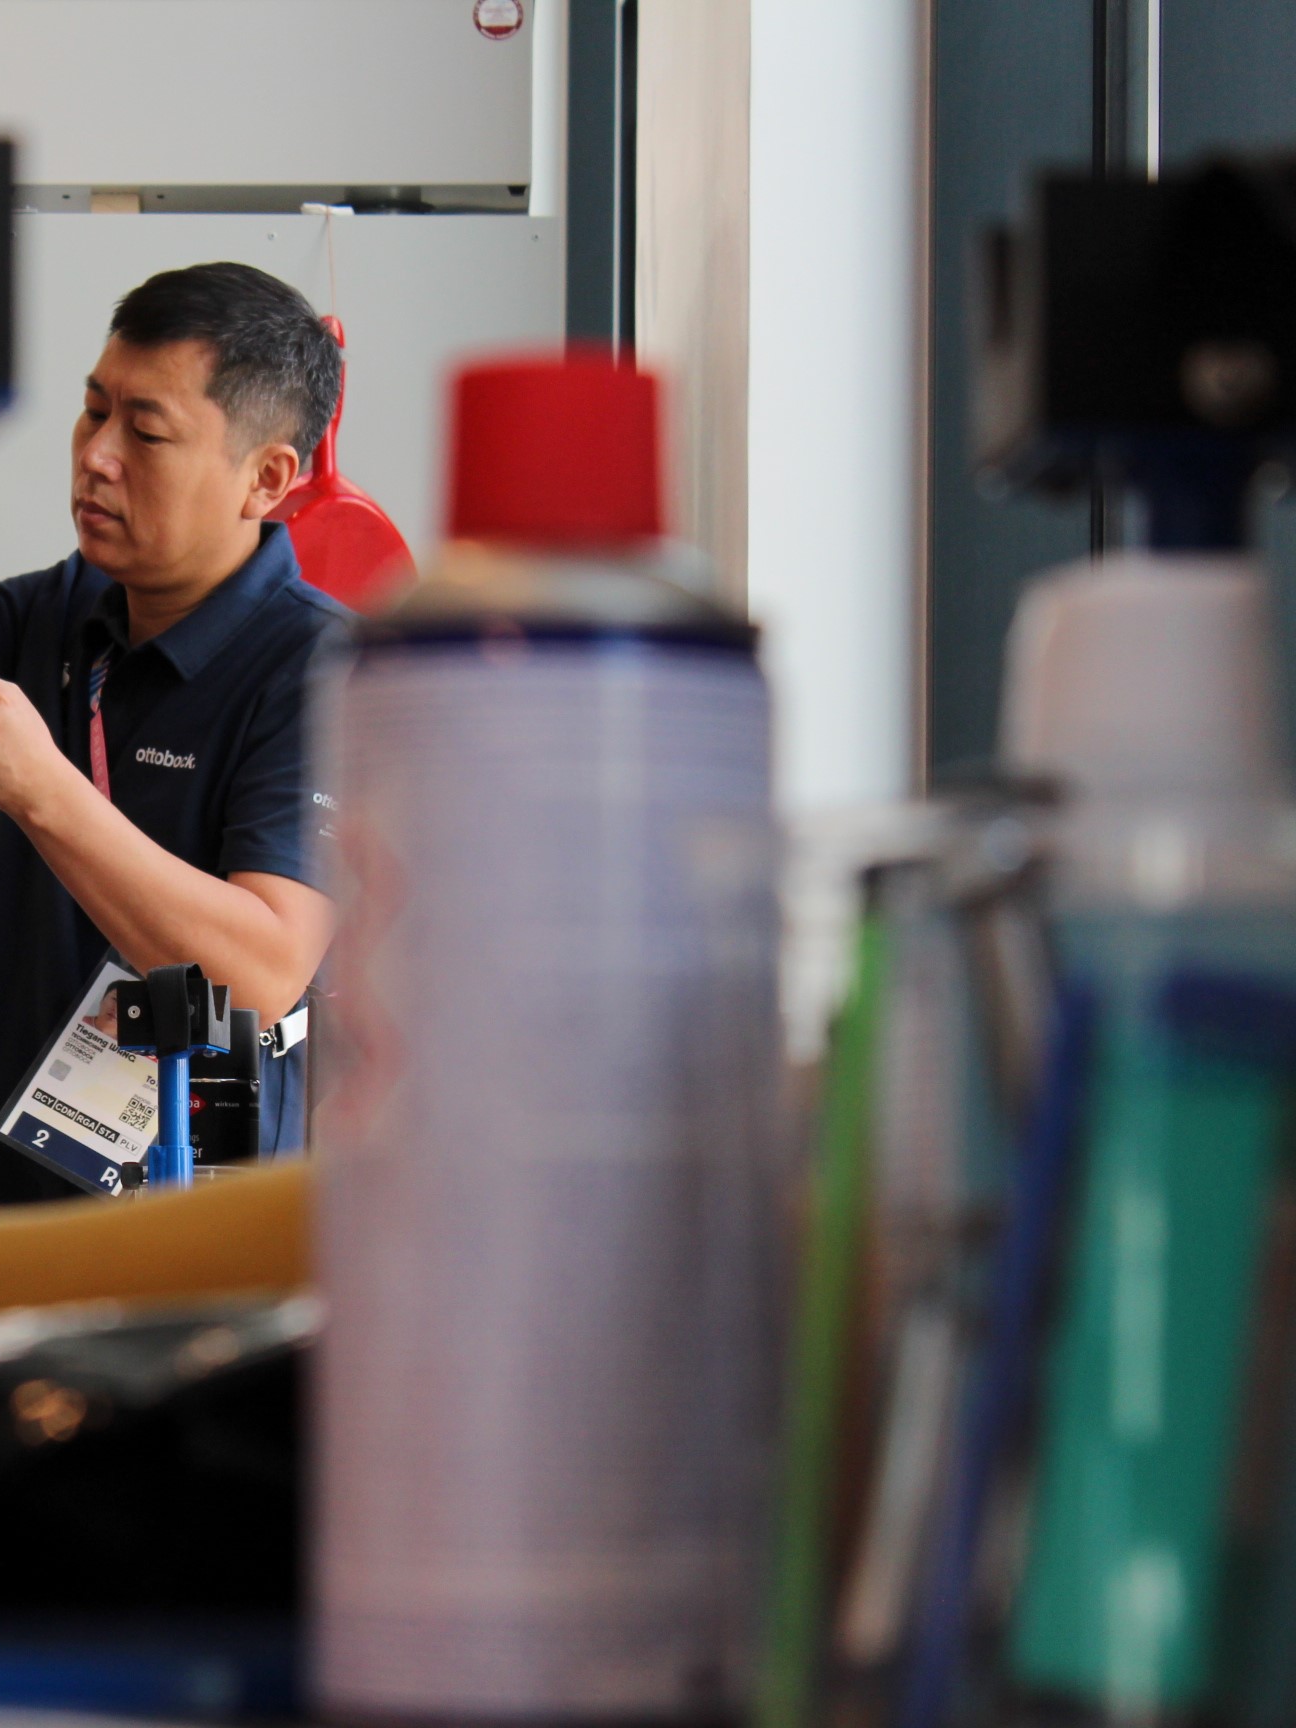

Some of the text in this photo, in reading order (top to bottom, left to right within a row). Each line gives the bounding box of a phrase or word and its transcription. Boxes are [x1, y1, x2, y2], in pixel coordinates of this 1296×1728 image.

[75, 1023, 109, 1048] Tiegang
[64, 1041, 94, 1060] OTTOBOCK
[34, 1090, 55, 1106] BCY
[55, 1103, 76, 1118] CDM
[76, 1114, 96, 1130] RGA
[31, 1129, 50, 1149] 2
[97, 1126, 116, 1142] STA
[119, 1138, 139, 1152] PLV
[99, 1166, 119, 1187] R
